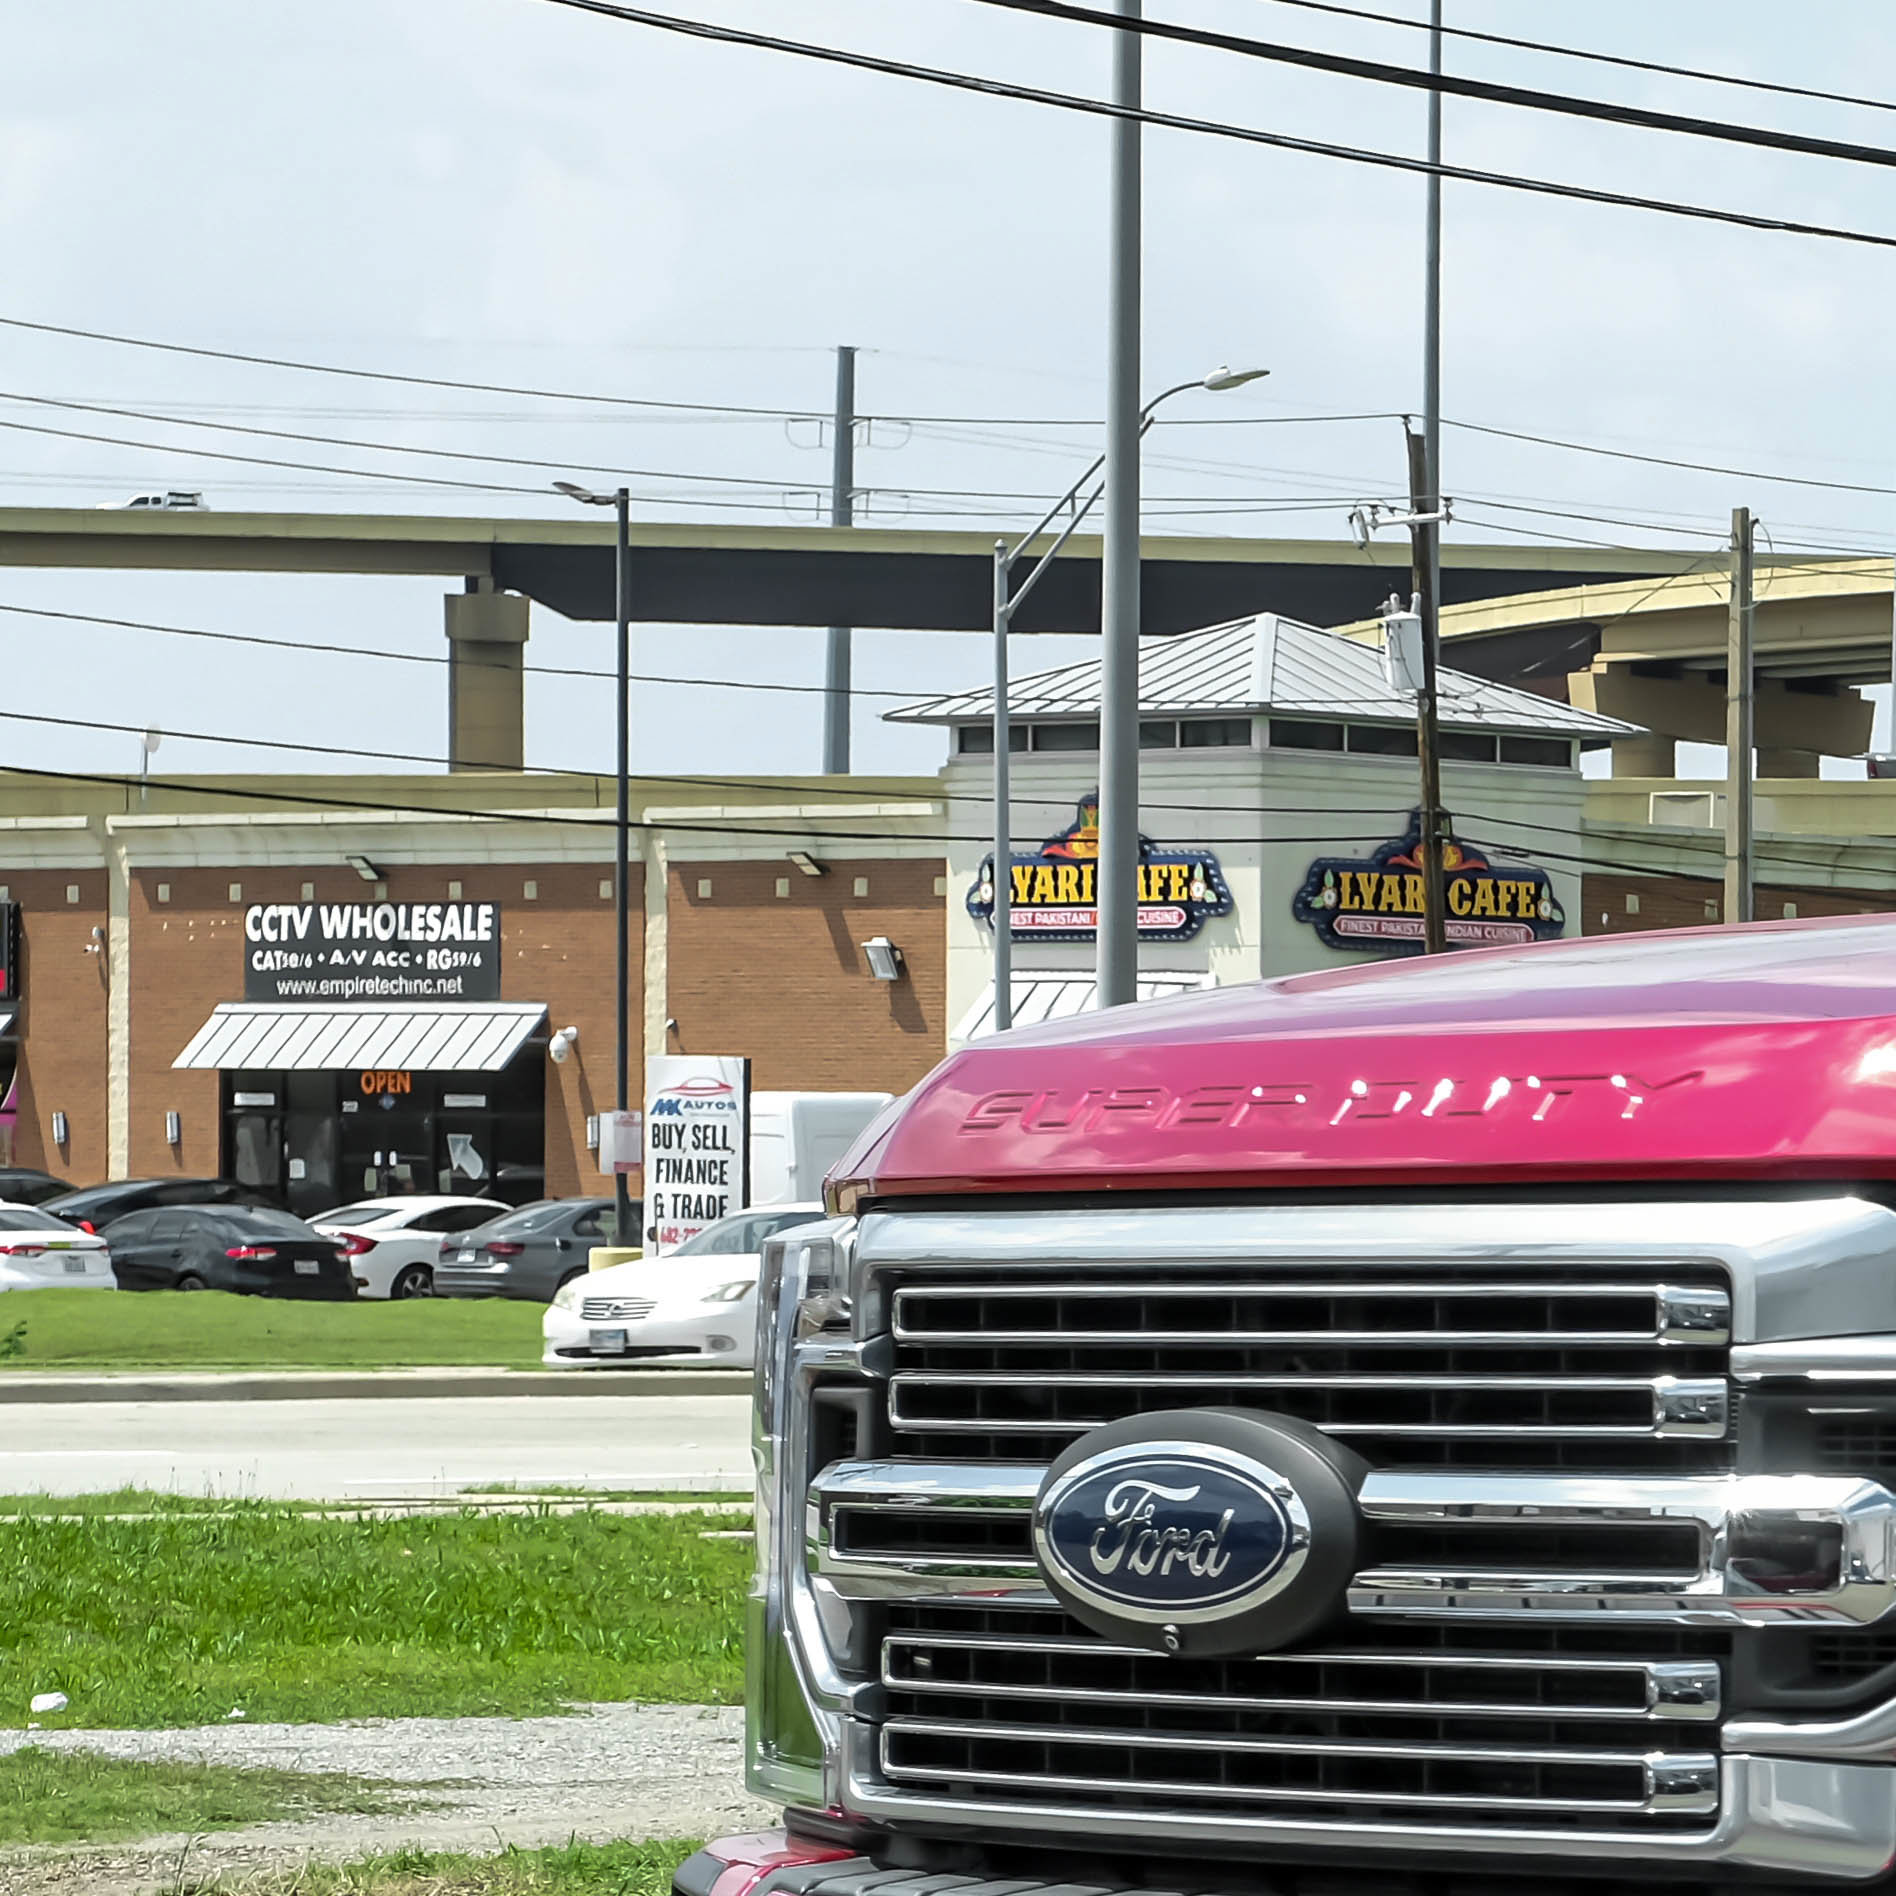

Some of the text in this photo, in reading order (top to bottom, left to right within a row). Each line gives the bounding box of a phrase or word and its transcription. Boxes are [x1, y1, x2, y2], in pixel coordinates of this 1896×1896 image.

[1009, 864, 1188, 903] YARI AFE
[1339, 871, 1536, 918] LYAR CAFE
[245, 904, 494, 942] CCTV WHOLESALE
[1341, 919, 1528, 943] FINEST PAKISTA NDIAN CUISINE
[329, 949, 367, 966] A/V
[372, 950, 410, 967] ACC
[277, 975, 463, 999] www.empiretechinc.net
[361, 1071, 412, 1094] OPEN
[683, 1101, 737, 1111] AUTOS
[957, 1070, 1706, 1136] SUPER DUTY
[652, 1123, 736, 1155] BUY, SELL,
[655, 1158, 729, 1185] FINANCE
[671, 1193, 729, 1220] TRADE
[1090, 1479, 1235, 1578] Ford
